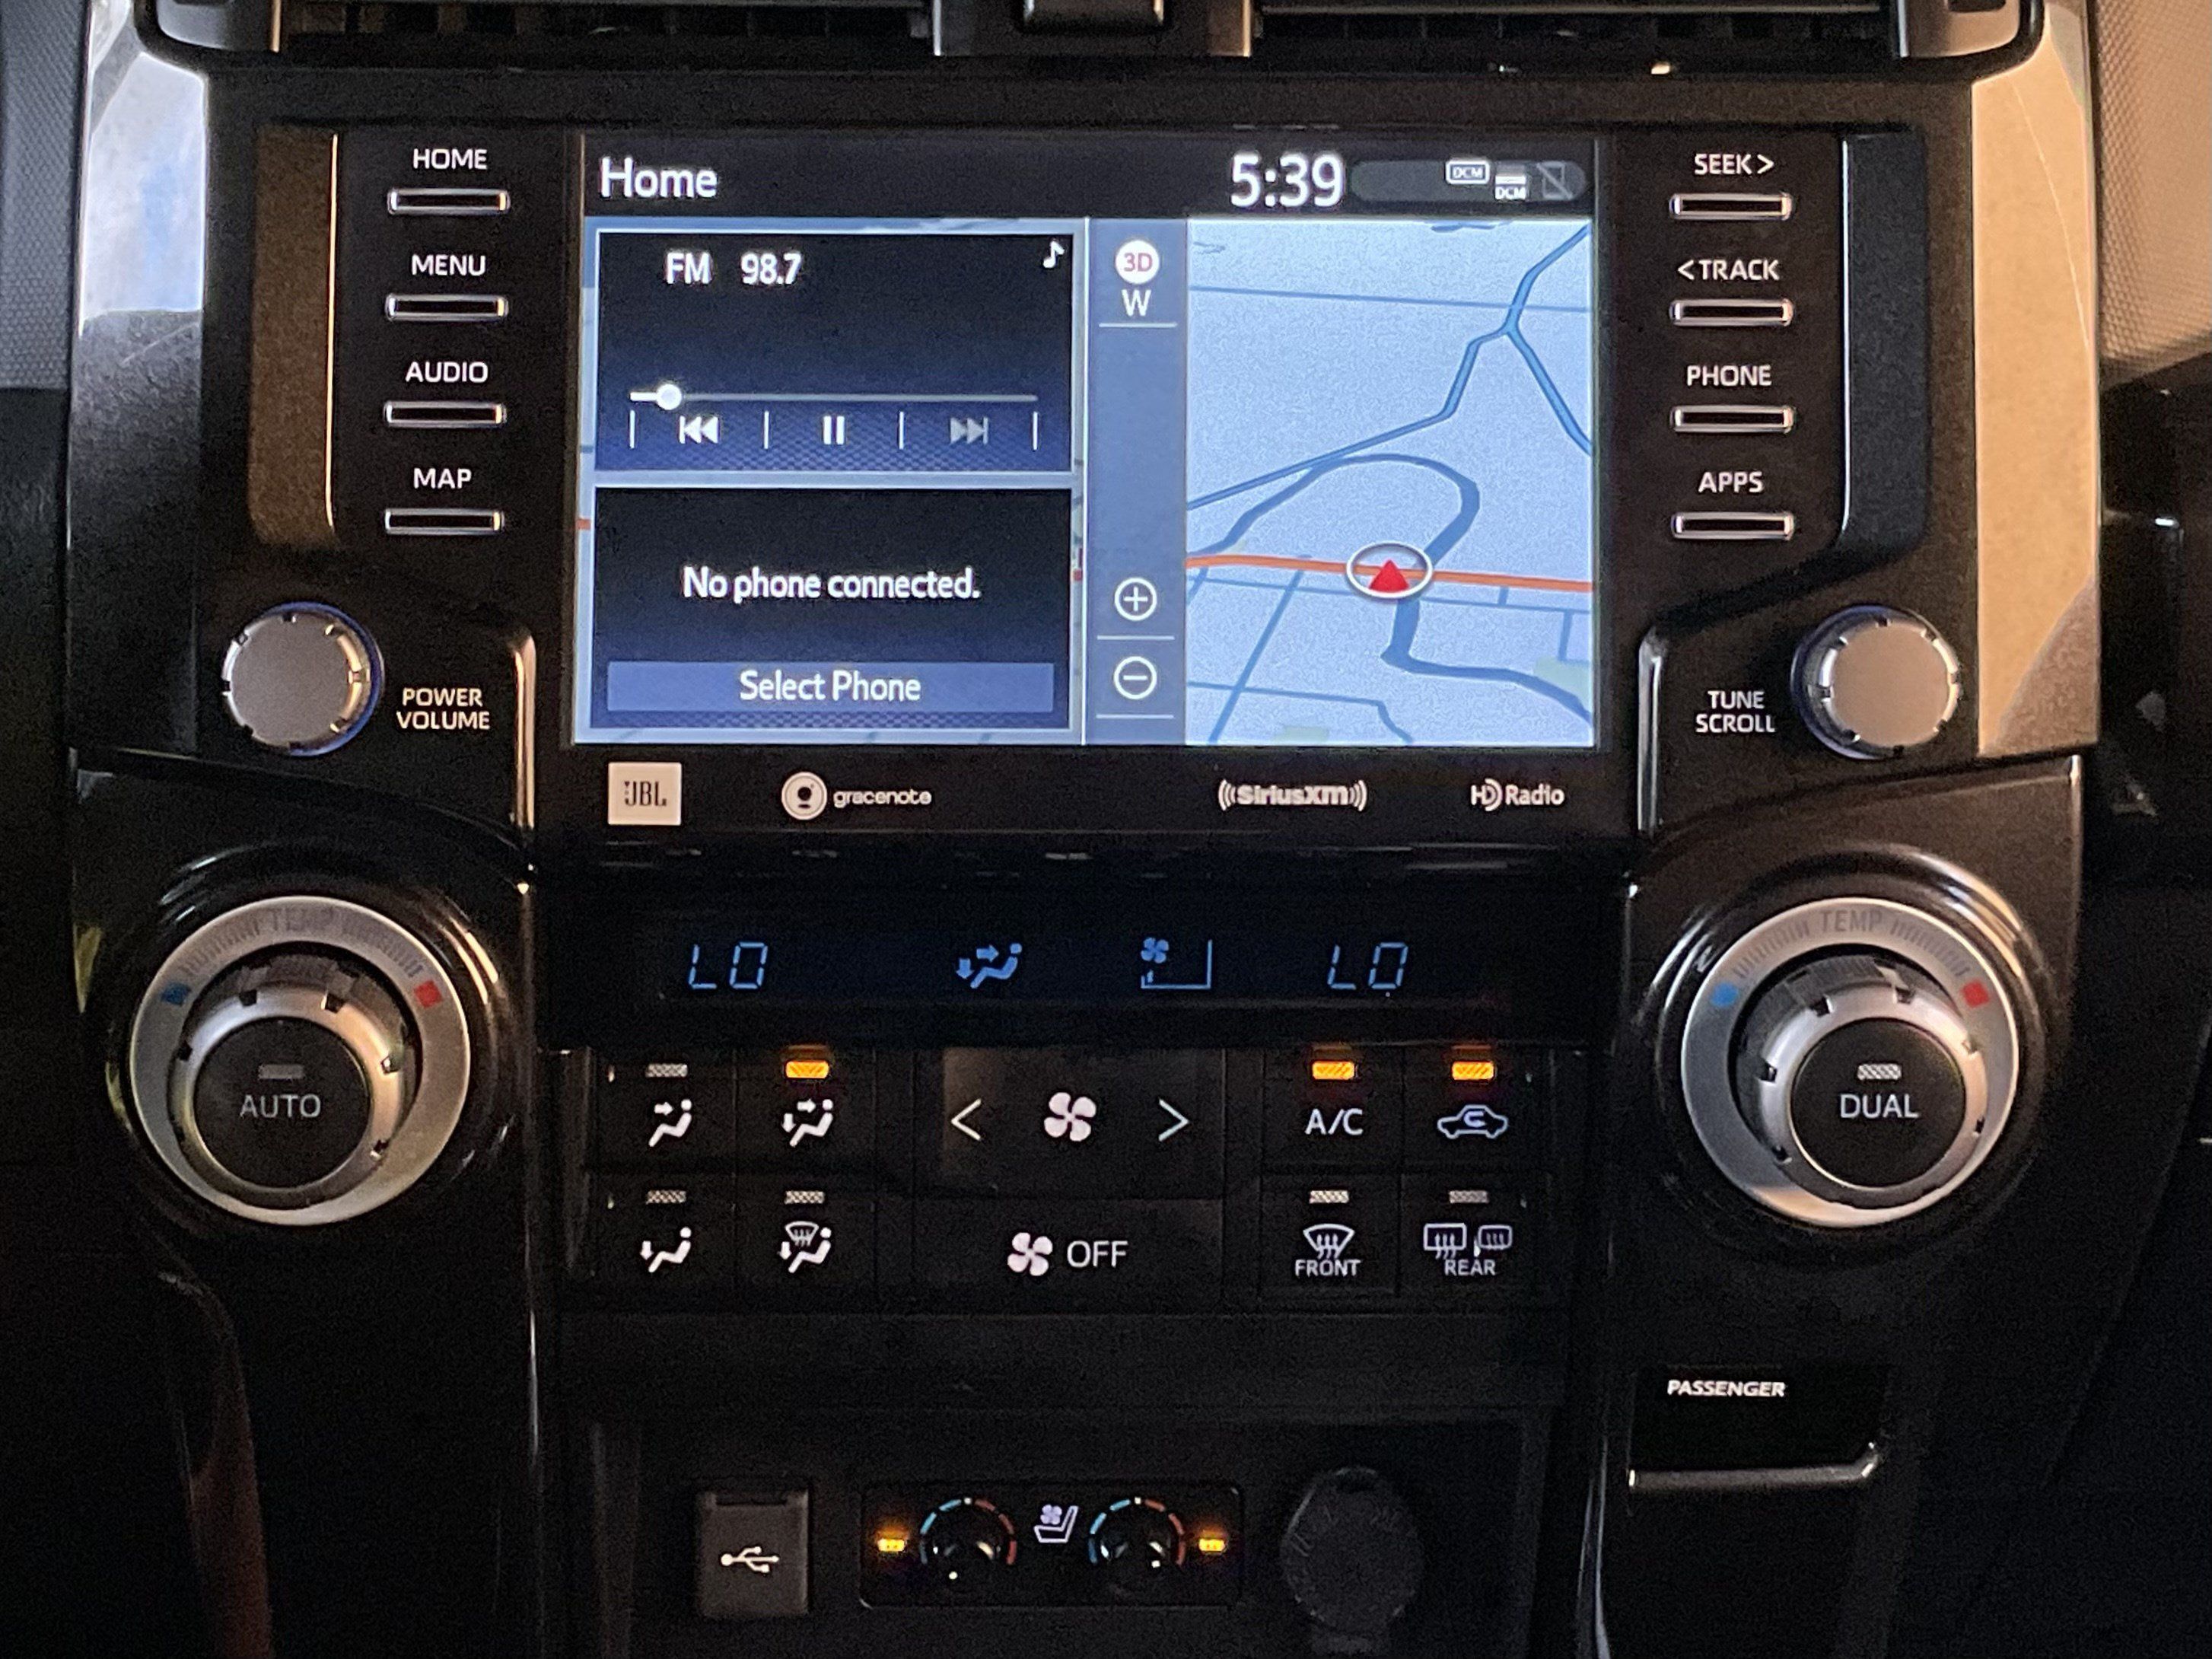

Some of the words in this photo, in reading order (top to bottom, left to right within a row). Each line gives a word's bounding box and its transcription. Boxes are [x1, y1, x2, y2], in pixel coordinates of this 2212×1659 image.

[412, 148, 488, 170] HOME
[600, 156, 718, 198] Home
[1230, 152, 1344, 207] 5:39
[1452, 165, 1484, 180] DCM
[1494, 185, 1527, 200] DCM
[411, 253, 486, 276] MENU
[666, 250, 712, 285] FM
[740, 251, 802, 285] 98.7
[1123, 252, 1153, 272] 3D
[1120, 288, 1152, 317] W
[405, 361, 489, 383] AUDIO
[1687, 365, 1772, 387] PHONE
[413, 467, 472, 489] MAP
[1698, 471, 1764, 493] APPS
[683, 565, 728, 598] No
[734, 565, 822, 604] phone
[827, 566, 981, 599] connected.
[740, 669, 826, 701] Select
[832, 669, 921, 702] Phone
[402, 687, 483, 707] POWER
[1707, 690, 1765, 709] TUNE
[396, 711, 490, 730] VOLUME
[1695, 713, 1775, 734] SCROLL
[624, 781, 667, 807] JBL
[832, 788, 932, 809] gracenote
[1504, 783, 1566, 806] Radio
[1822, 910, 1883, 933] TEMP
[240, 1094, 321, 1118] AUTO
[1840, 1093, 1920, 1119] DUAL
[1304, 1107, 1364, 1135] A/C
[1067, 1240, 1128, 1268] OFF
[1294, 1259, 1361, 1277] FRONT
[1443, 1257, 1496, 1276] REAR
[1666, 1379, 1786, 1397] PASSENGER
